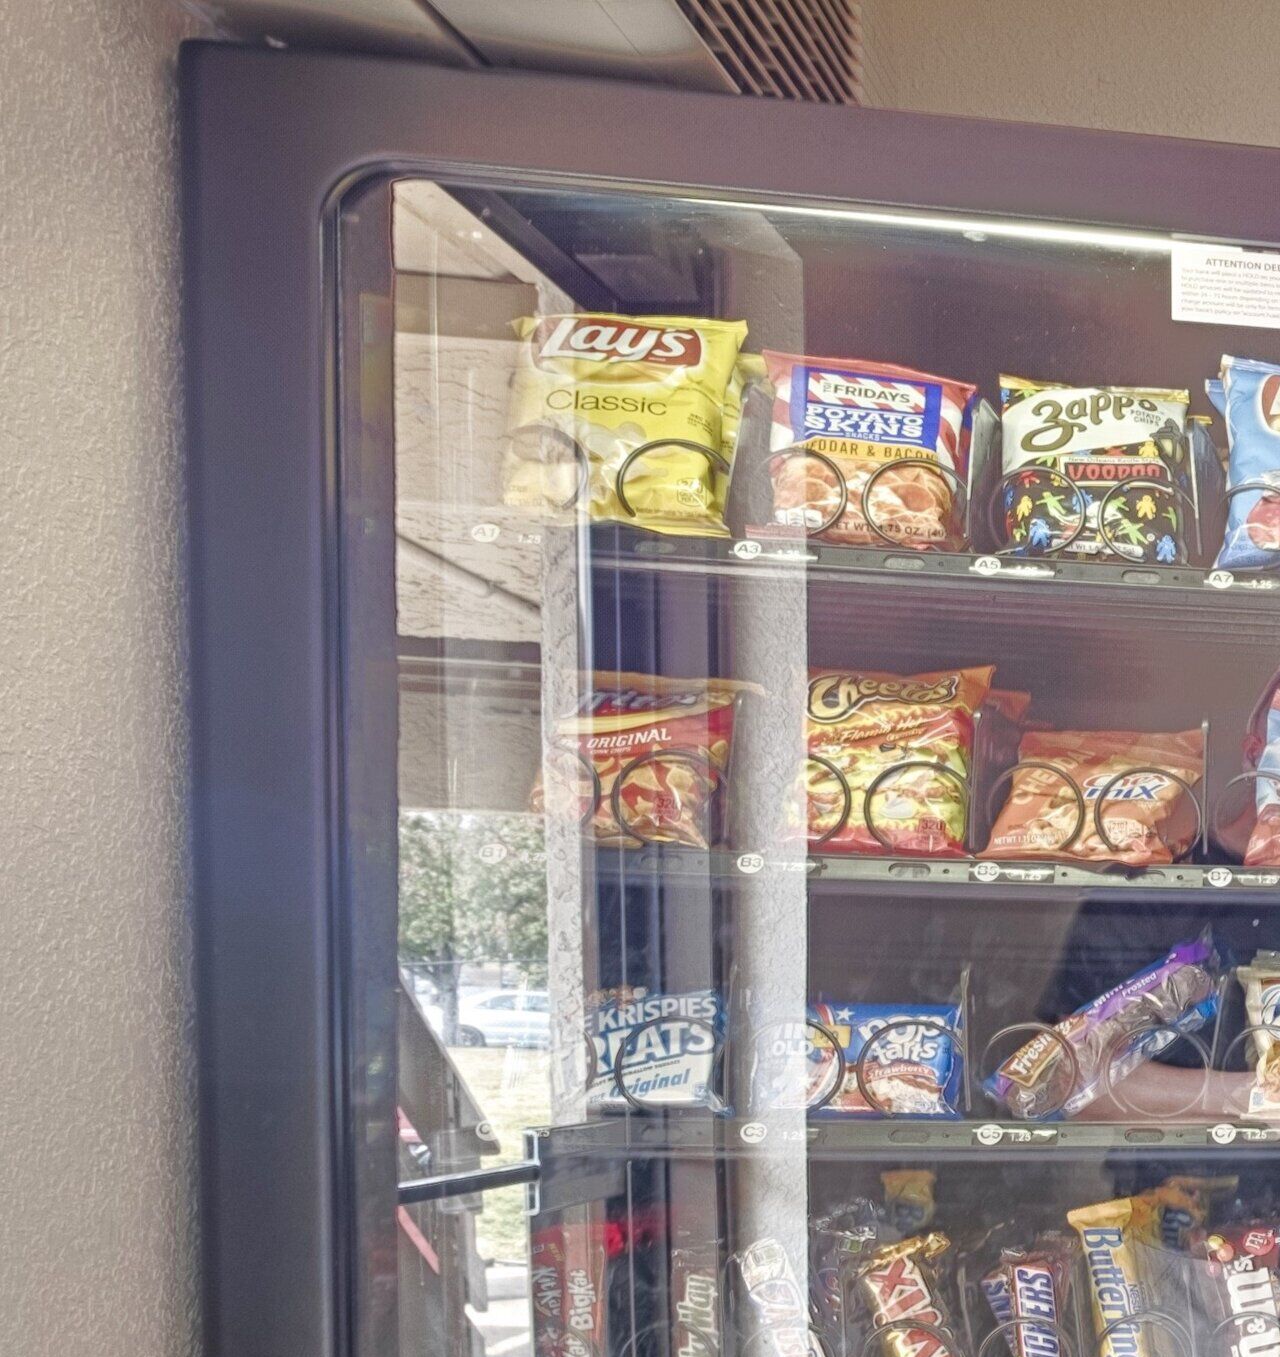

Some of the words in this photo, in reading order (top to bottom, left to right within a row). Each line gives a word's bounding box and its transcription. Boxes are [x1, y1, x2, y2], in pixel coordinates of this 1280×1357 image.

[1205, 257, 1262, 271] ATTENTION
[540, 318, 695, 363] Lay's
[545, 389, 668, 416] Classic
[833, 382, 911, 404] FRIDAYS
[806, 404, 923, 427] POTATO
[805, 416, 923, 439] SKINS
[867, 445, 876, 457] &
[884, 446, 937, 461] BACON
[1067, 463, 1161, 481] VOODOO
[809, 675, 953, 719] Cheetos
[586, 728, 672, 749] ORIGINAL
[1121, 972, 1157, 998] Frosted
[598, 996, 718, 1033] KRISPIES
[873, 1041, 938, 1066] tarts
[608, 1068, 692, 1098] Original
[868, 1064, 930, 1082] Strawberry
